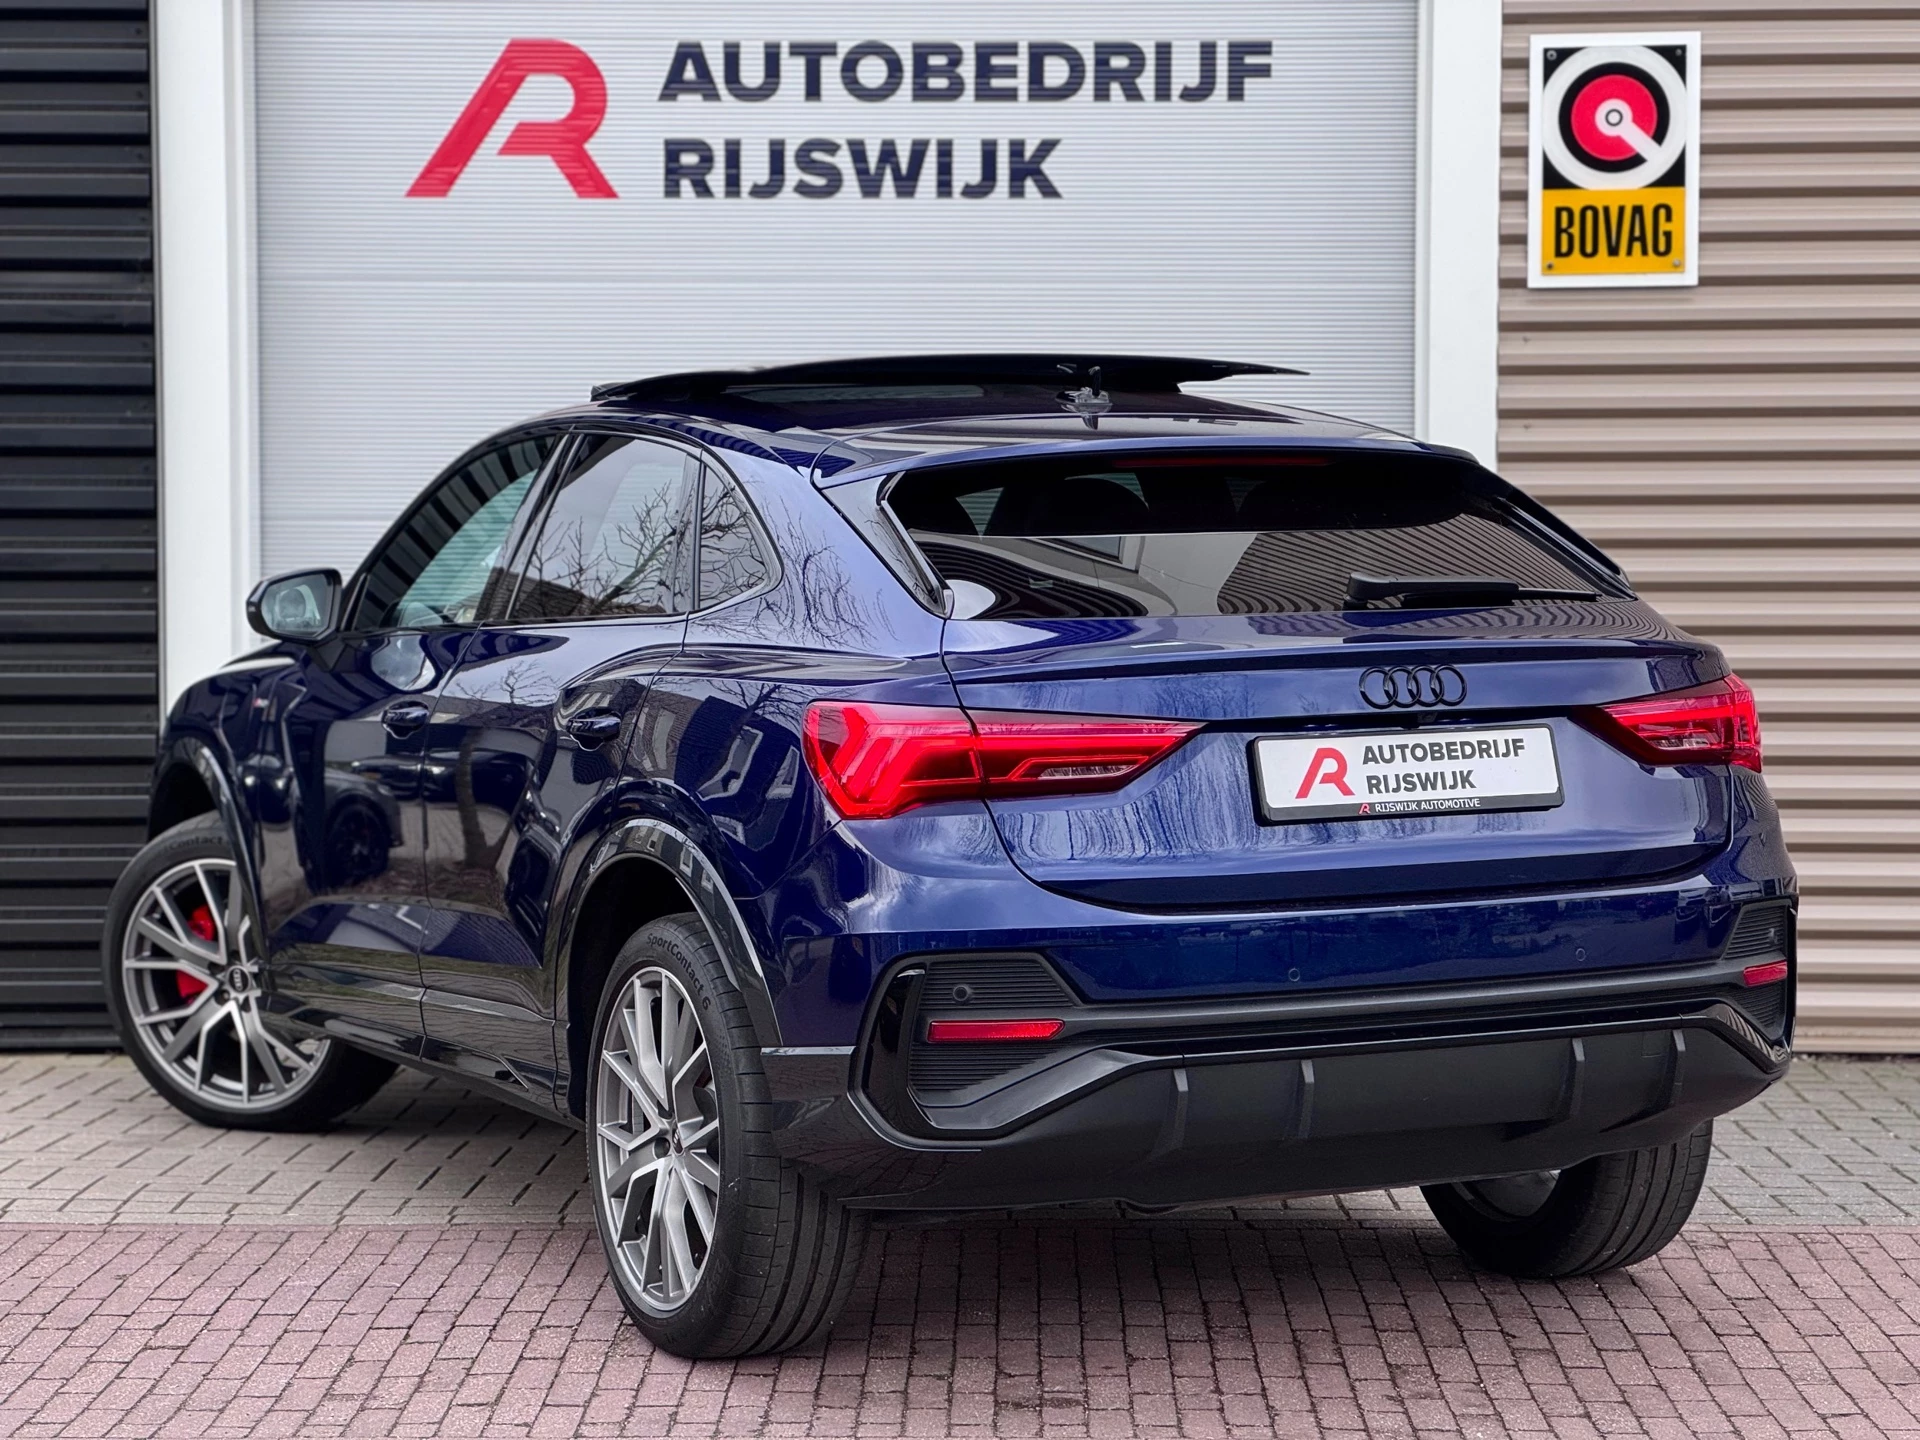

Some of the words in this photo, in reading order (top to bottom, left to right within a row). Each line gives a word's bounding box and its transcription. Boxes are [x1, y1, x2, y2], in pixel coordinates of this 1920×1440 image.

[659, 41, 1273, 103] AUTOBEDRIJF
[664, 138, 1062, 200] RIJSWIJK
[1554, 203, 1673, 259] BOVAG
[1362, 738, 1525, 765] AUTOBEDRIJF
[1366, 769, 1477, 795] RIJSWIJK
[1375, 801, 1419, 812] RIJSWIJK
[1420, 798, 1481, 811] AUTOMOTIVE
[702, 996, 711, 1010] 6
